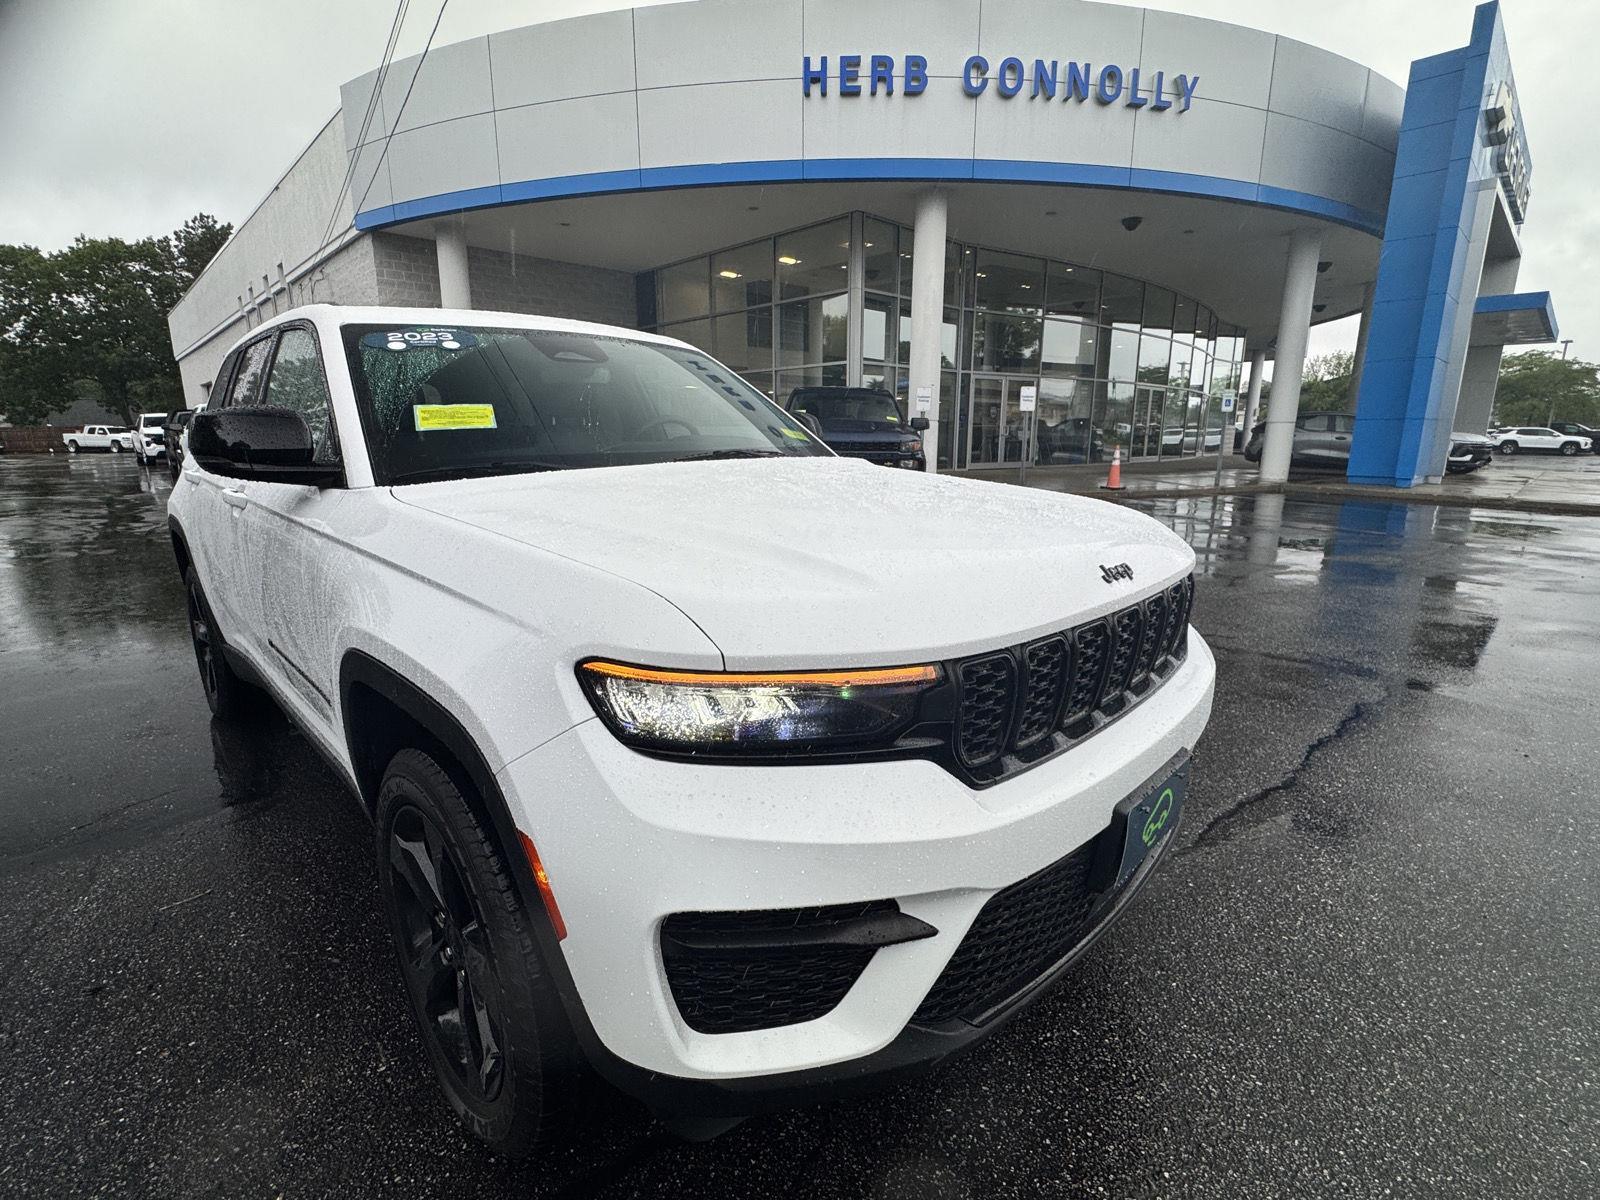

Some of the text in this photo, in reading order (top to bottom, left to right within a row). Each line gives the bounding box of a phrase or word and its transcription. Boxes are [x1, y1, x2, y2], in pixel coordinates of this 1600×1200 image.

[802, 55, 1200, 114] HERB CONNOLLY
[386, 332, 454, 341] 2023
[1099, 562, 1134, 584] Jeep
